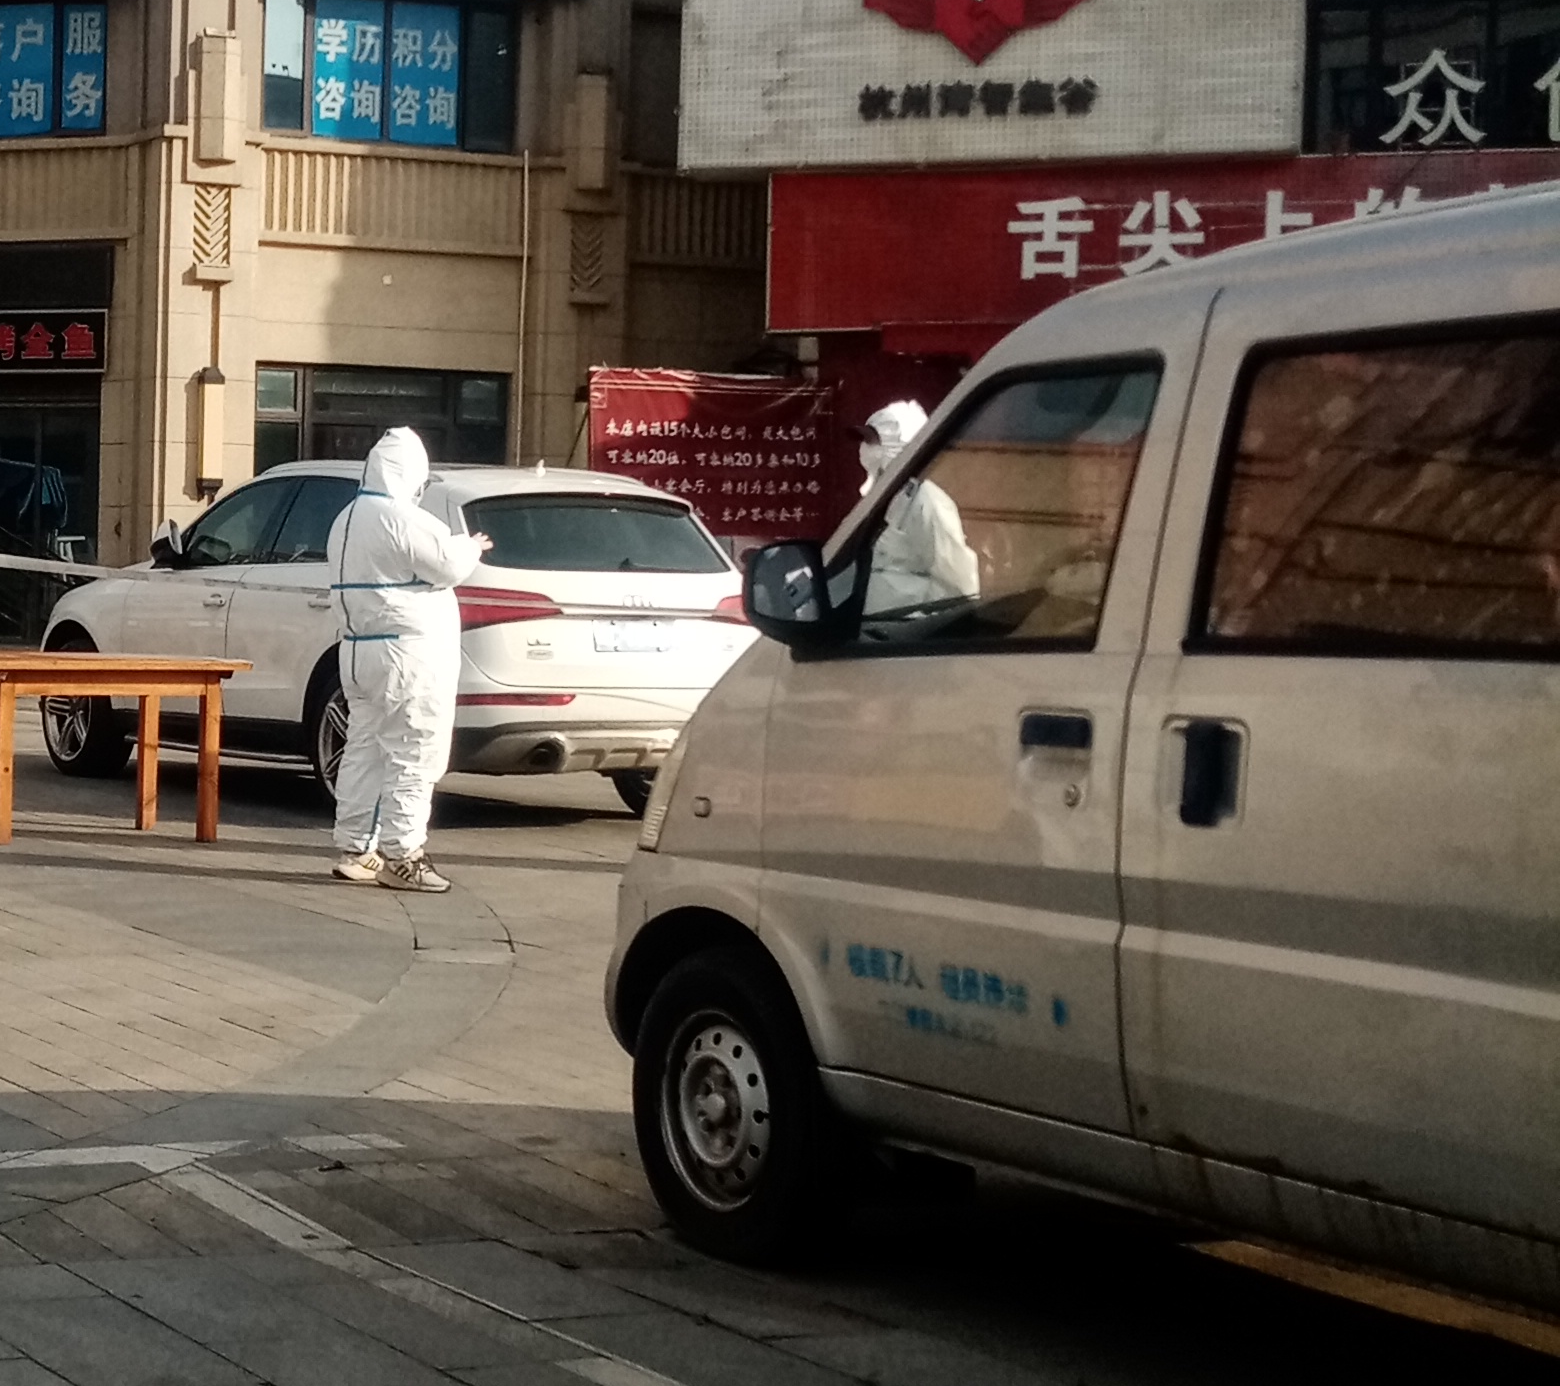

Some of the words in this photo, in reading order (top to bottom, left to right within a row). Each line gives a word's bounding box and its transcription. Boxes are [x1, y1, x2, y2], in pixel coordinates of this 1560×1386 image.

[316, 19, 381, 66] 学历
[391, 27, 459, 72] 积分
[315, 79, 381, 124] 咨询
[391, 86, 458, 130] 咨询
